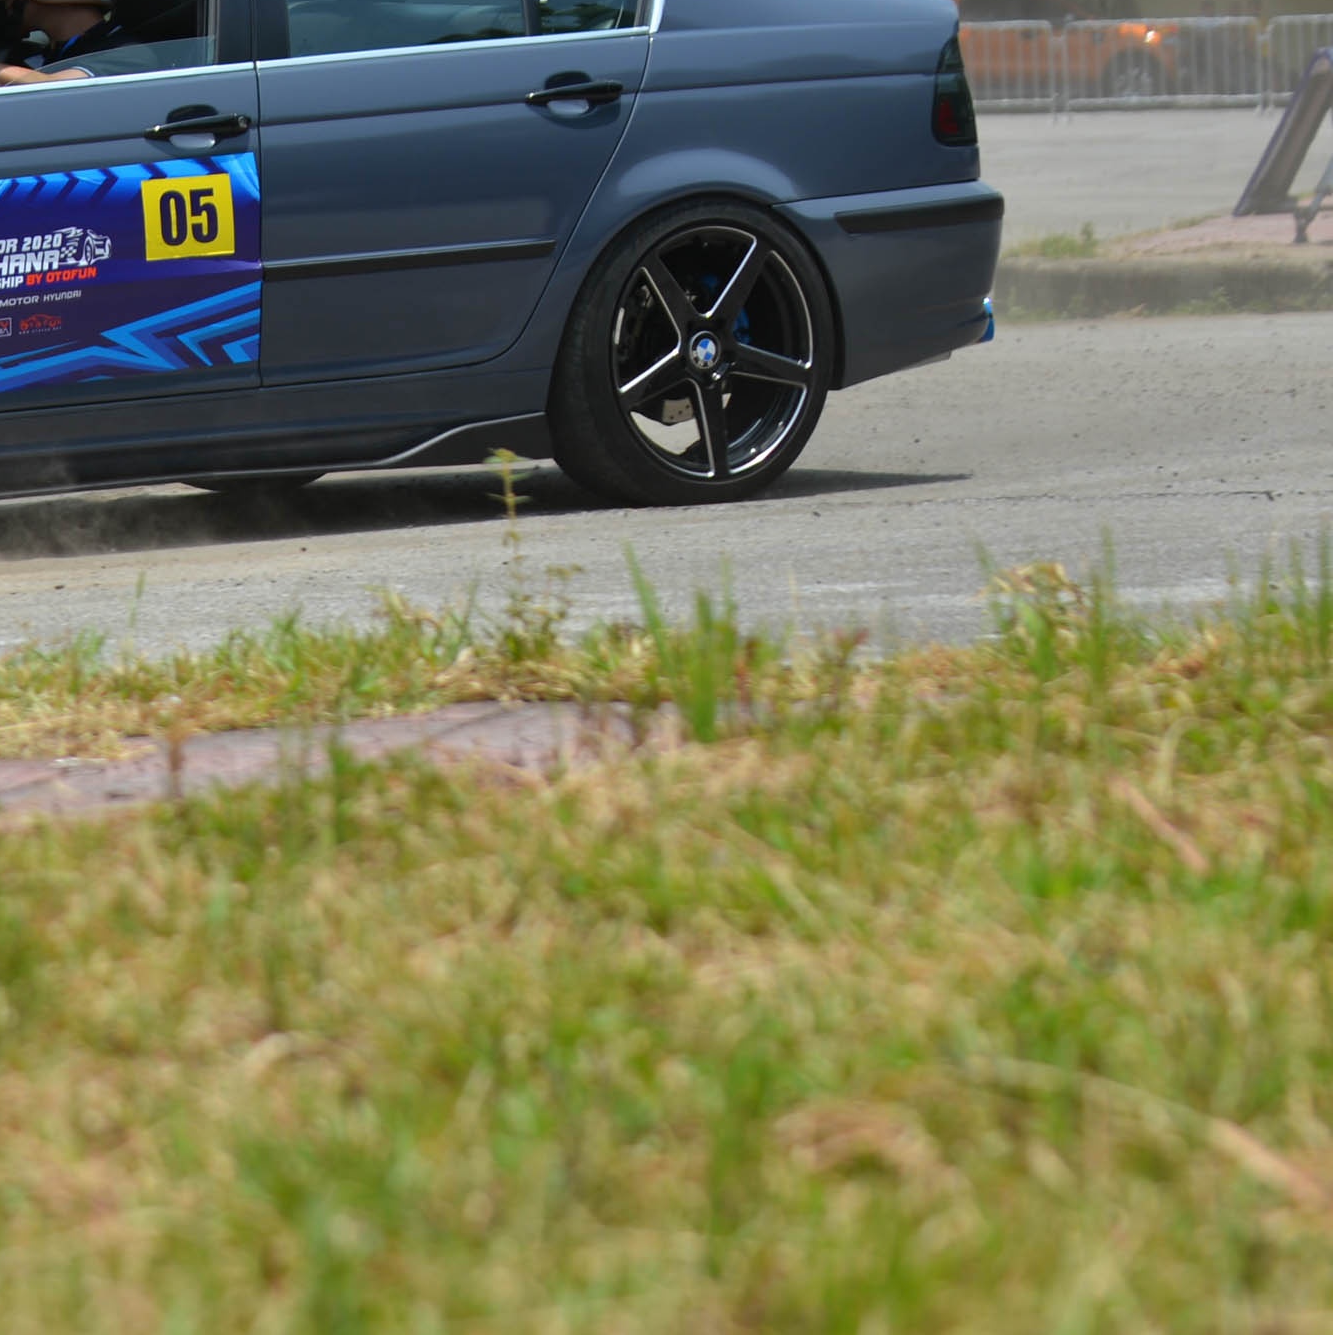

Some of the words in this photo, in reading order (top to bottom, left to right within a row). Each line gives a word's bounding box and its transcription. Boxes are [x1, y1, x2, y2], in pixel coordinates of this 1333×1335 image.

[159, 188, 218, 246] 05
[22, 233, 62, 252] 2020
[26, 272, 43, 286] BY
[46, 266, 97, 283] OTOFUN
[43, 289, 82, 302] HYUNDAI
